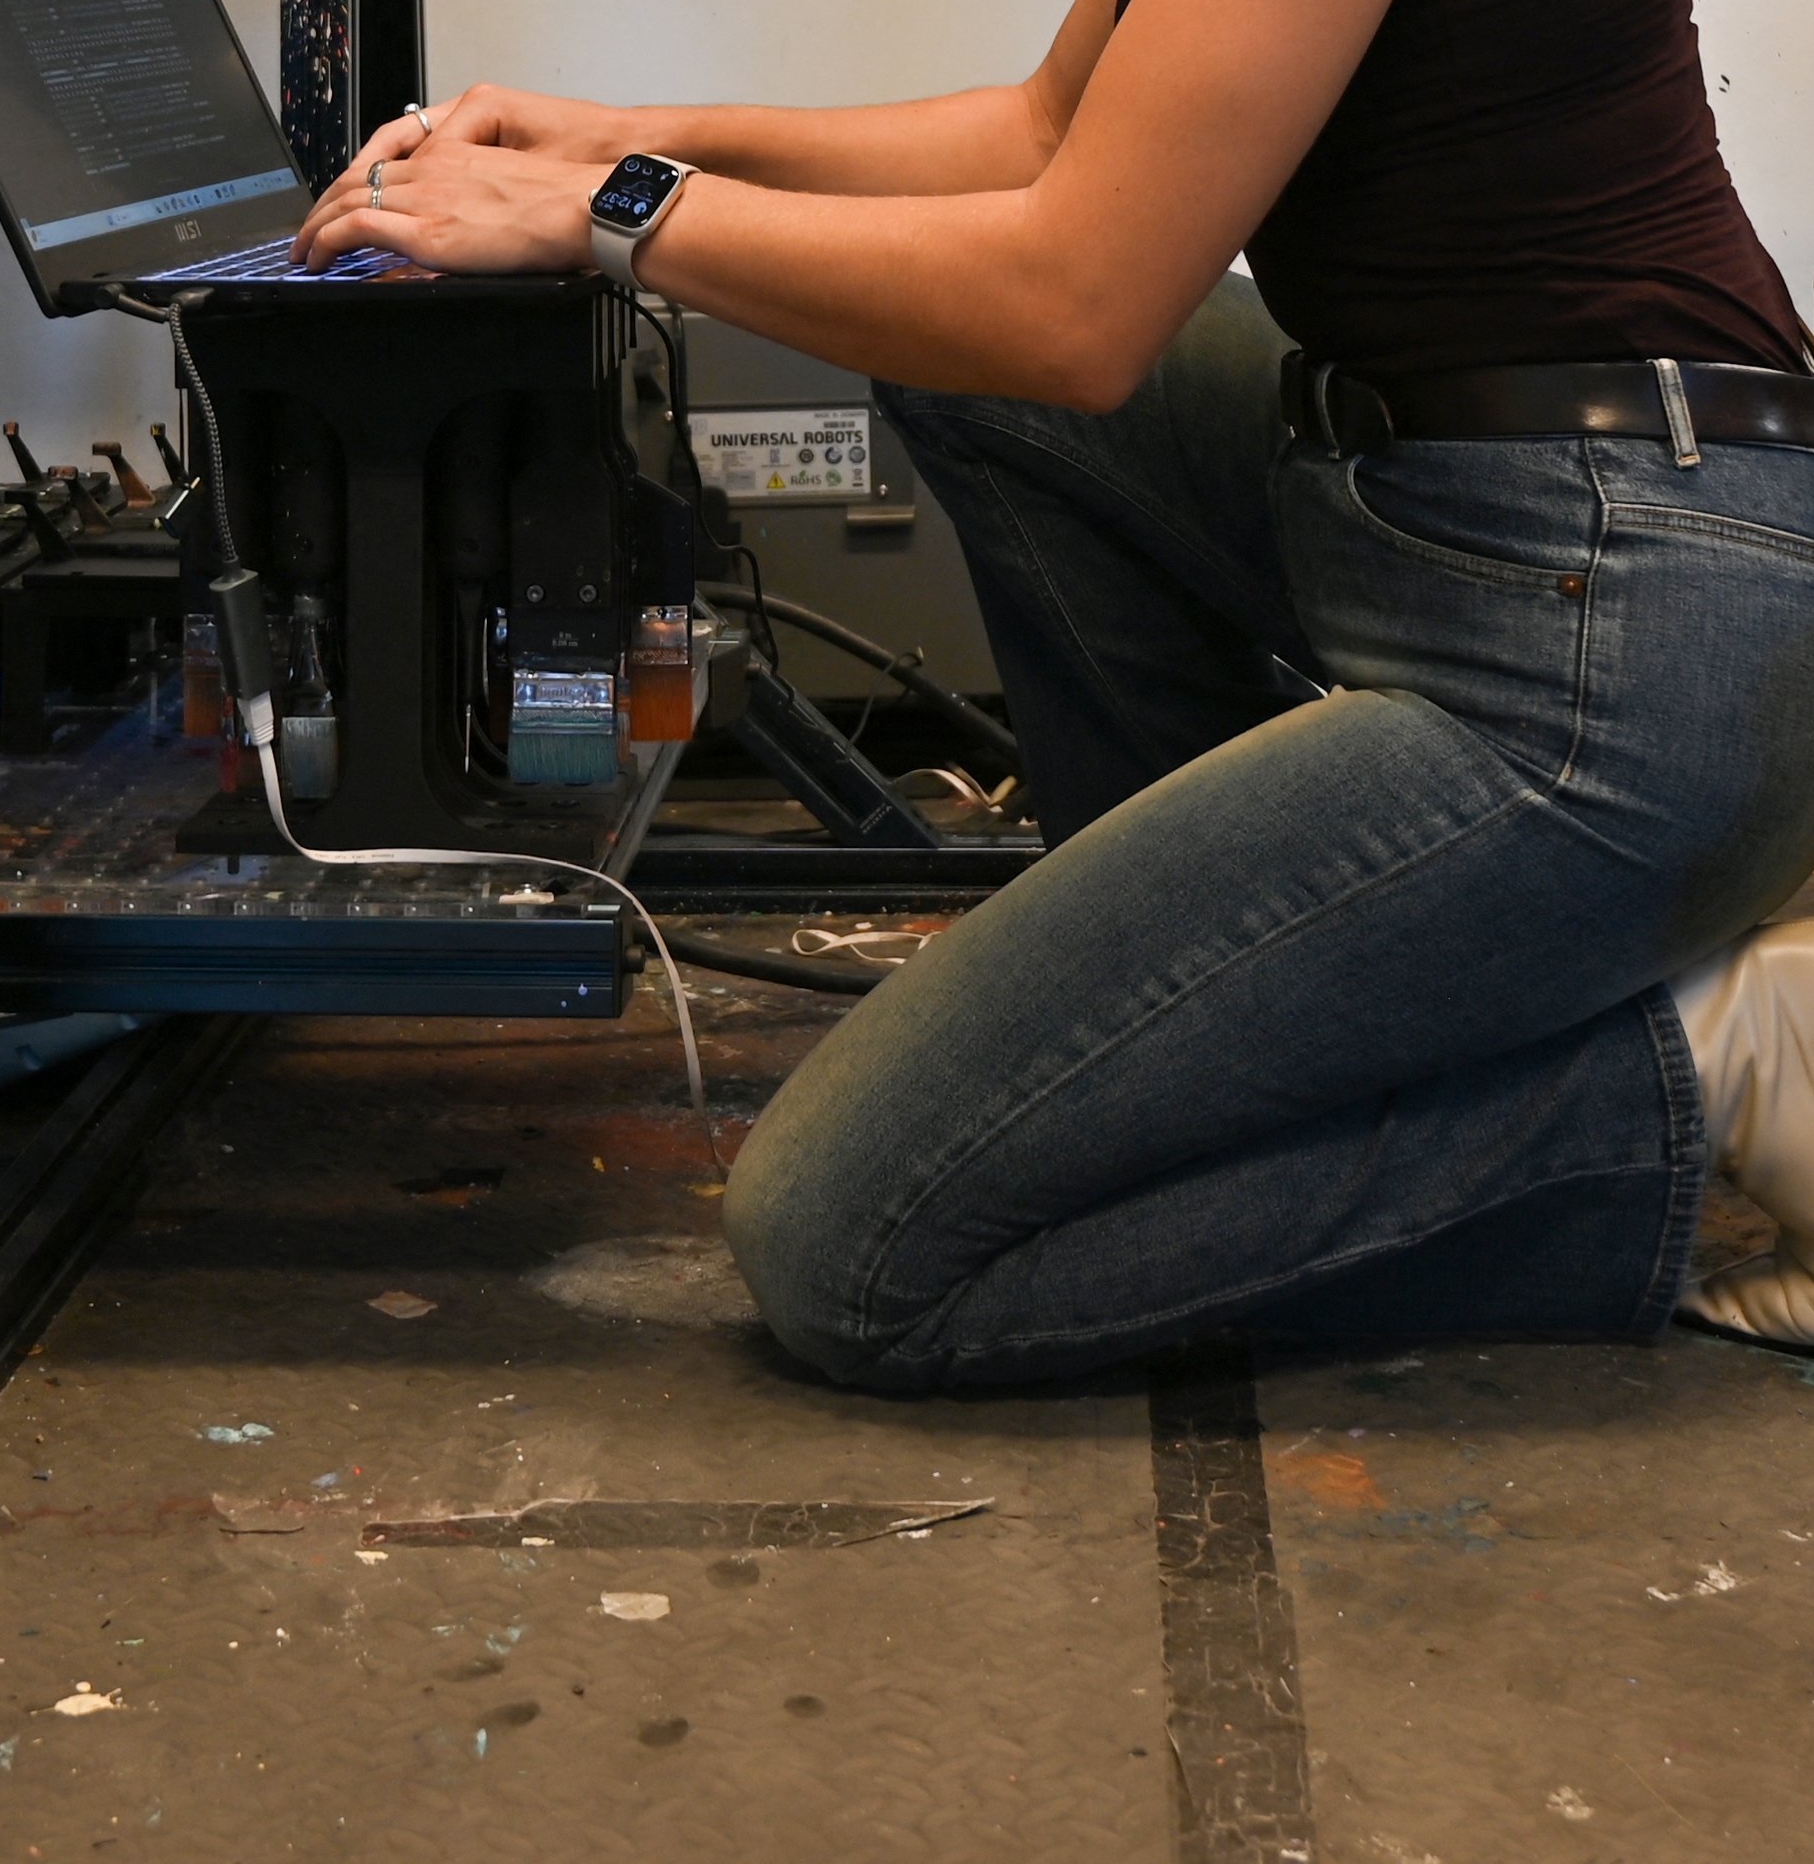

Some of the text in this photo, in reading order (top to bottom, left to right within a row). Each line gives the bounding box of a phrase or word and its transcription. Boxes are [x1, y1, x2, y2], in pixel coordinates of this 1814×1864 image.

[602, 192, 632, 209] 12:37
[711, 431, 864, 447] UNIVERSAL ROBOTS
